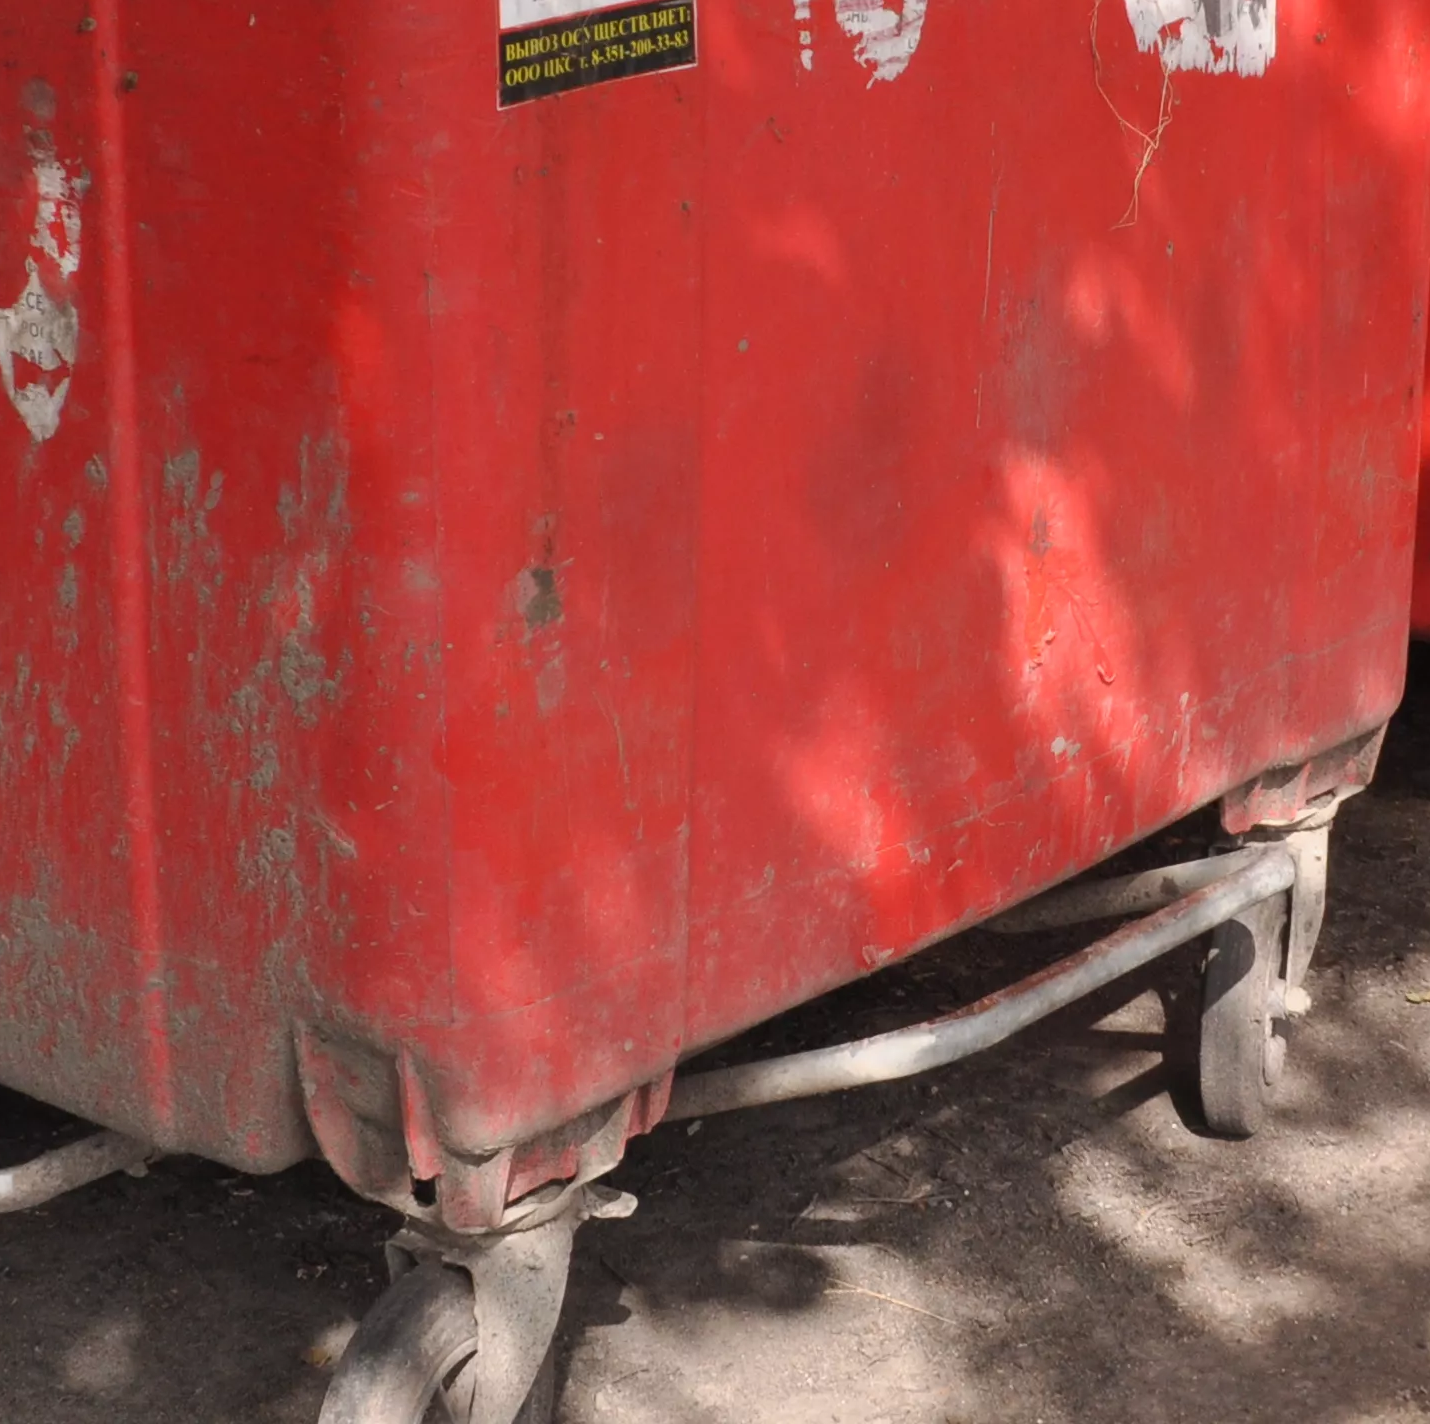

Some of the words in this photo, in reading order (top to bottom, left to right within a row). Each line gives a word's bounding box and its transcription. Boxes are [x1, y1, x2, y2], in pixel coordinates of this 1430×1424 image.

[505, 63, 541, 87] ООО
[544, 55, 575, 78] ЦКС
[591, 29, 689, 66] 8-351-200-33-83
[506, 32, 559, 62] ВЫВОЗ
[561, 6, 691, 49] ОСУЩЕСТВЛЯЕТ:
